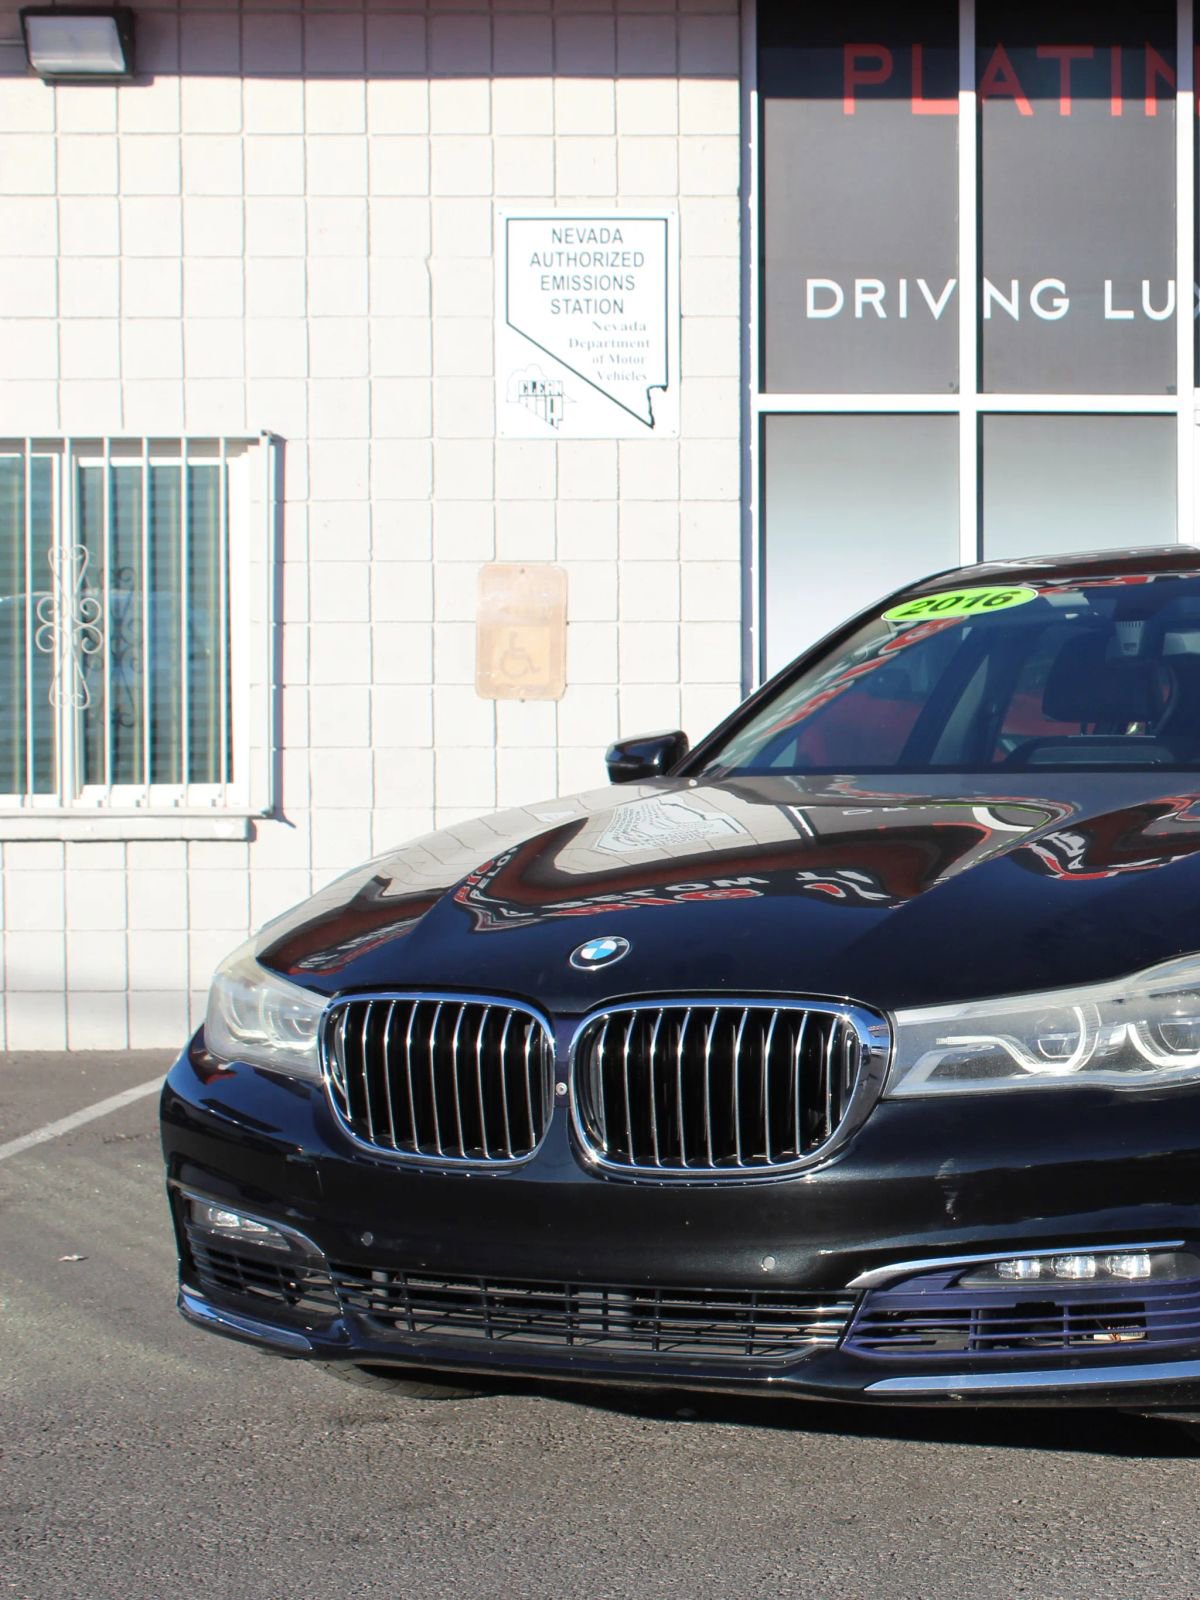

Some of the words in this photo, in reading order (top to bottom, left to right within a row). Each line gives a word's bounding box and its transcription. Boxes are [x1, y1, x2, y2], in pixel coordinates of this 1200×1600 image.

[551, 228, 624, 245] NEVADA
[529, 252, 645, 268] AUTHORIZED
[540, 275, 636, 292] EMISSIONS
[550, 299, 624, 315] STATION
[806, 277, 1070, 321] DRIVNG
[592, 321, 648, 332] Nevada
[568, 338, 650, 352] Department
[896, 590, 1022, 617] 2016
